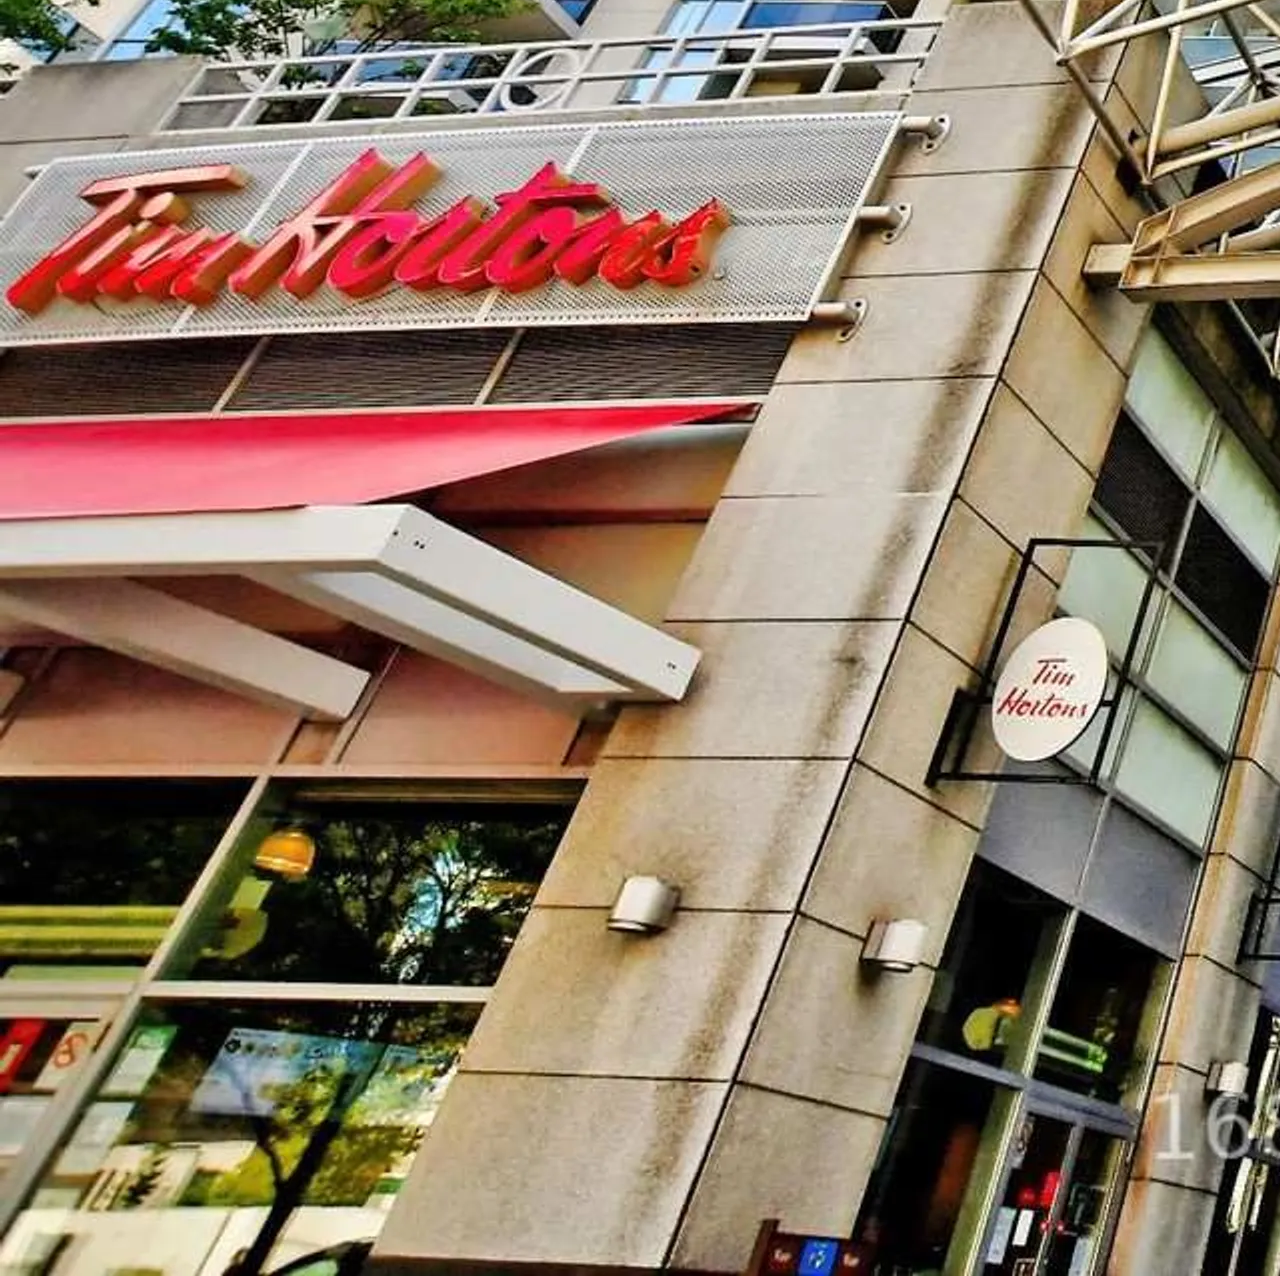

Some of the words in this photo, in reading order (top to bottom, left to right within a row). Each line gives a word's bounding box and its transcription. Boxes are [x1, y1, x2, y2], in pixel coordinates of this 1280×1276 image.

[5, 162, 257, 315] Tim
[228, 147, 731, 304] Hortons
[1032, 657, 1075, 686] Tim
[996, 686, 1089, 718] Hortons
